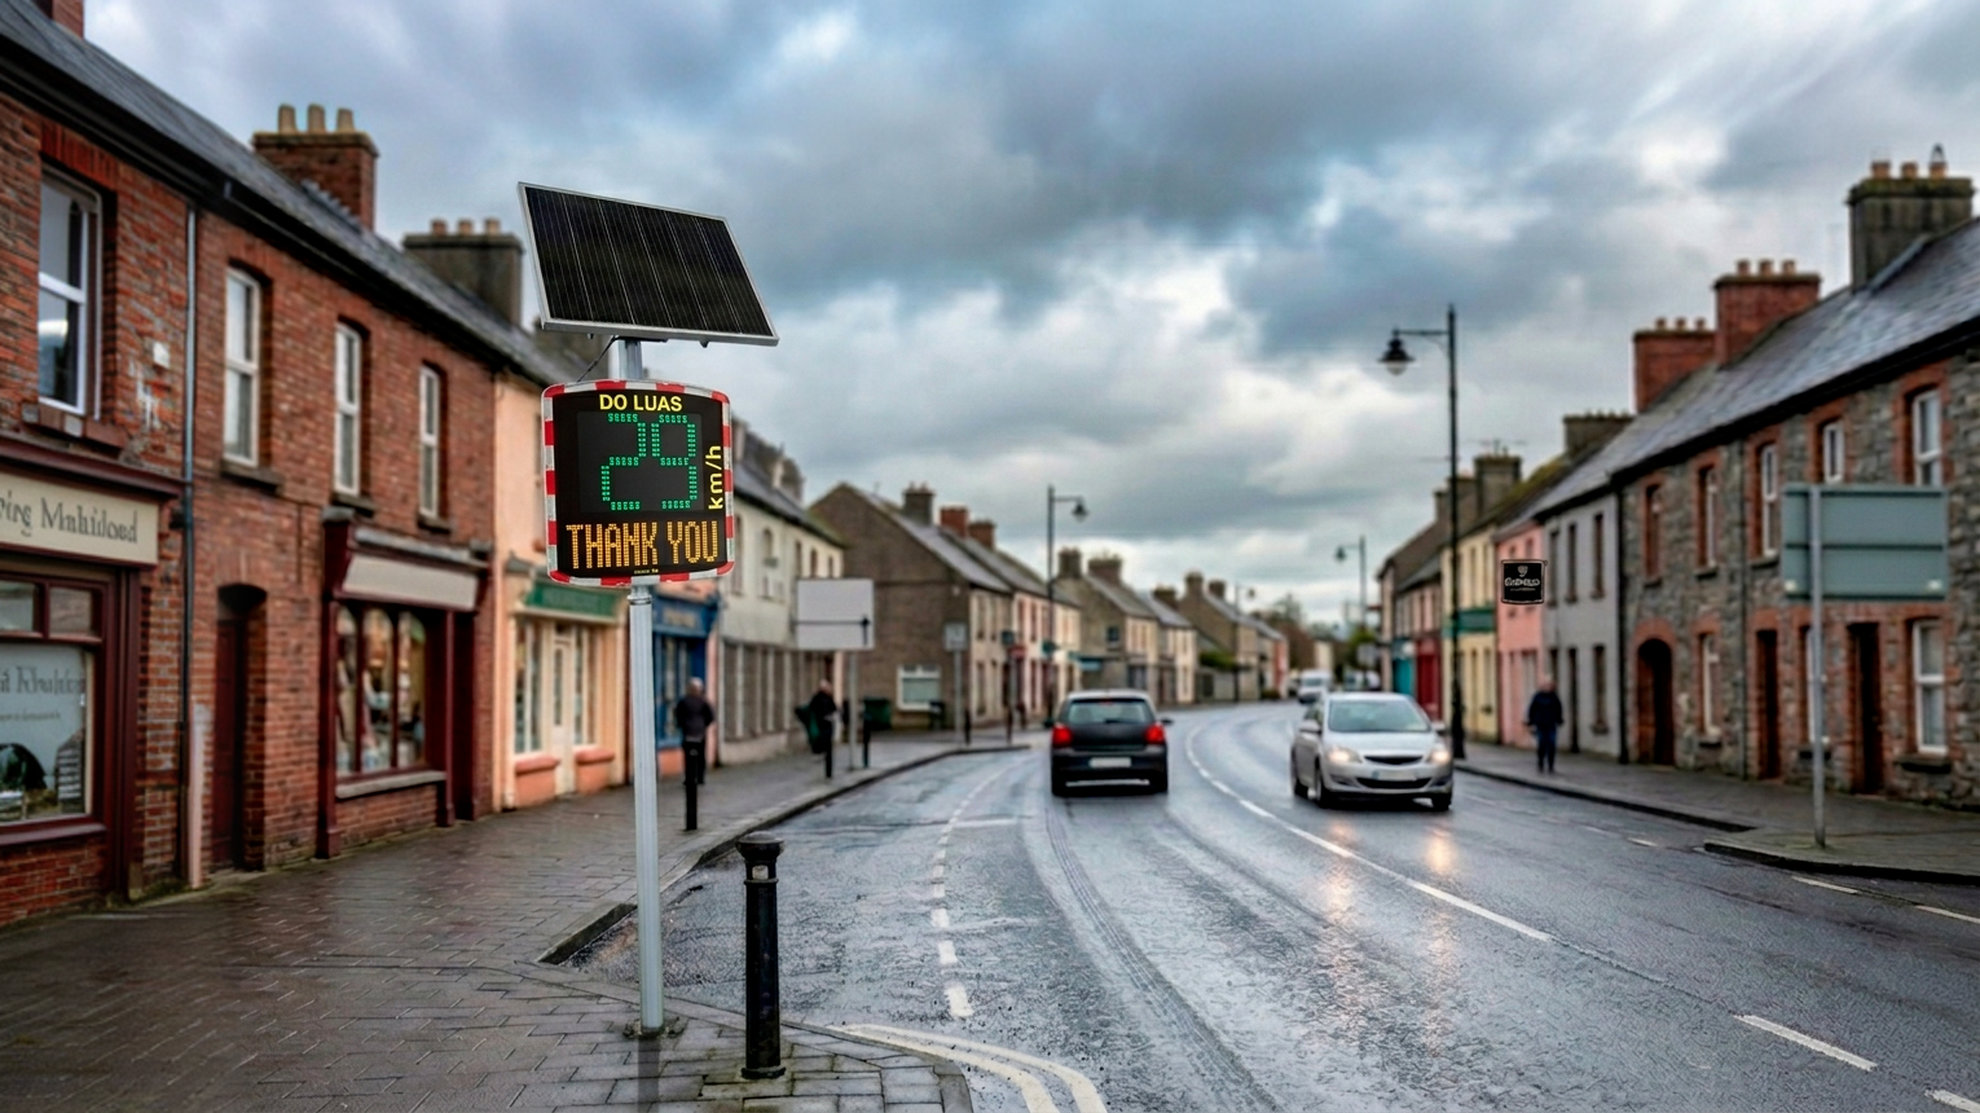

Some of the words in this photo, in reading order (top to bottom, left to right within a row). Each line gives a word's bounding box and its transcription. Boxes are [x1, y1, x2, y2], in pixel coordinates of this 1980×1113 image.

[599, 394, 627, 410] DO
[633, 395, 682, 411] LUAS
[601, 413, 697, 510] 29
[705, 445, 723, 510] km/h
[566, 522, 658, 569] THANK
[667, 520, 718, 564] YOU
